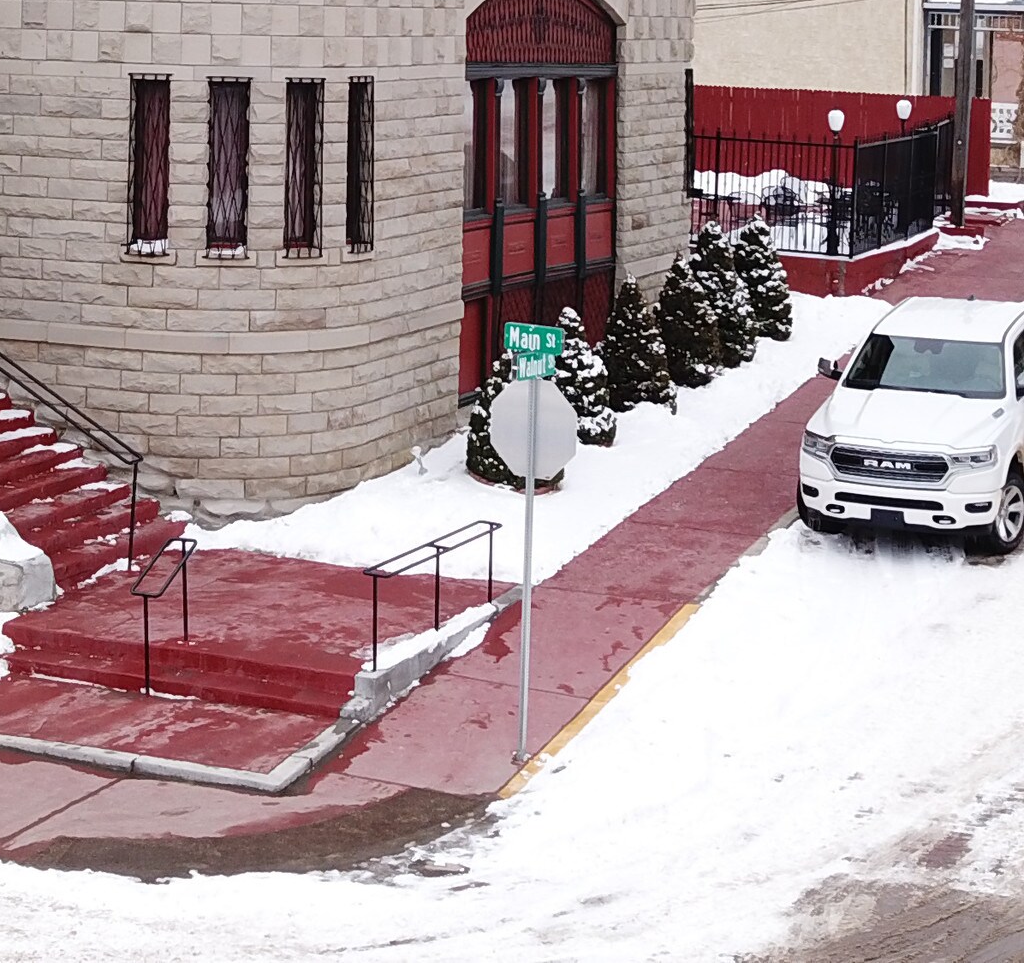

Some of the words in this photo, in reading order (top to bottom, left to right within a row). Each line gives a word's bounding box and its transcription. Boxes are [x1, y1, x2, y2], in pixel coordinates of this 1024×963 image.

[509, 326, 541, 351] Main
[546, 333, 556, 348] St
[519, 353, 546, 378] Walnut
[863, 459, 911, 469] RAM
